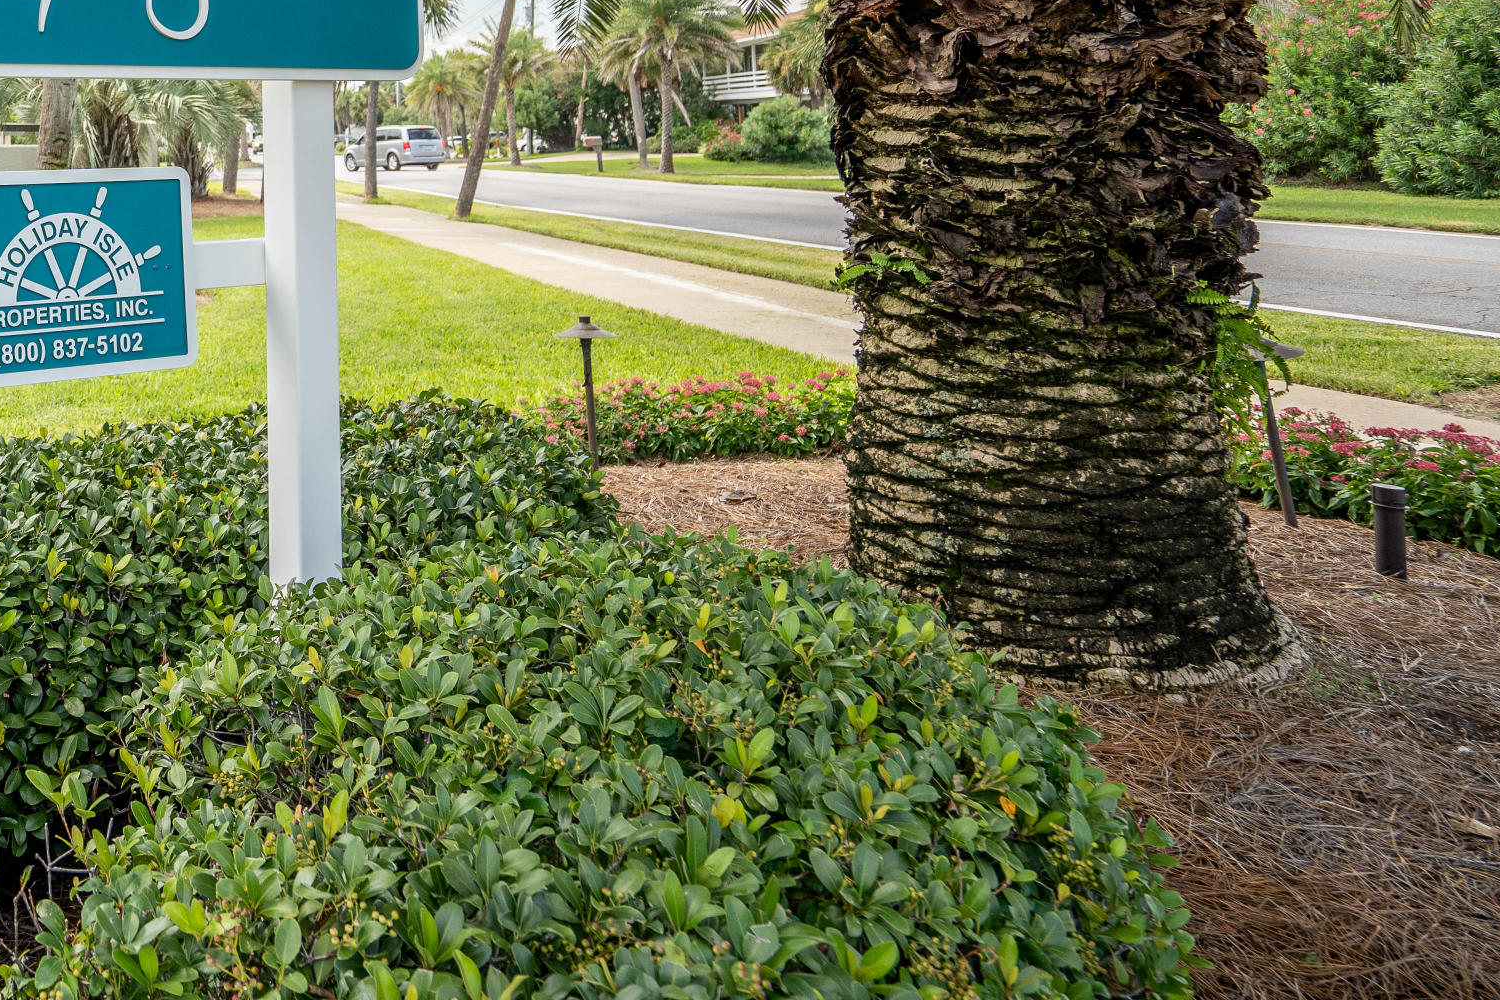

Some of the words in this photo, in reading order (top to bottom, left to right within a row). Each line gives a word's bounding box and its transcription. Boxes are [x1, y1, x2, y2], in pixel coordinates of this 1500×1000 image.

[93, 227, 135, 281] ISLE
[115, 298, 154, 318] INC.
[52, 331, 144, 360] 837-5102
